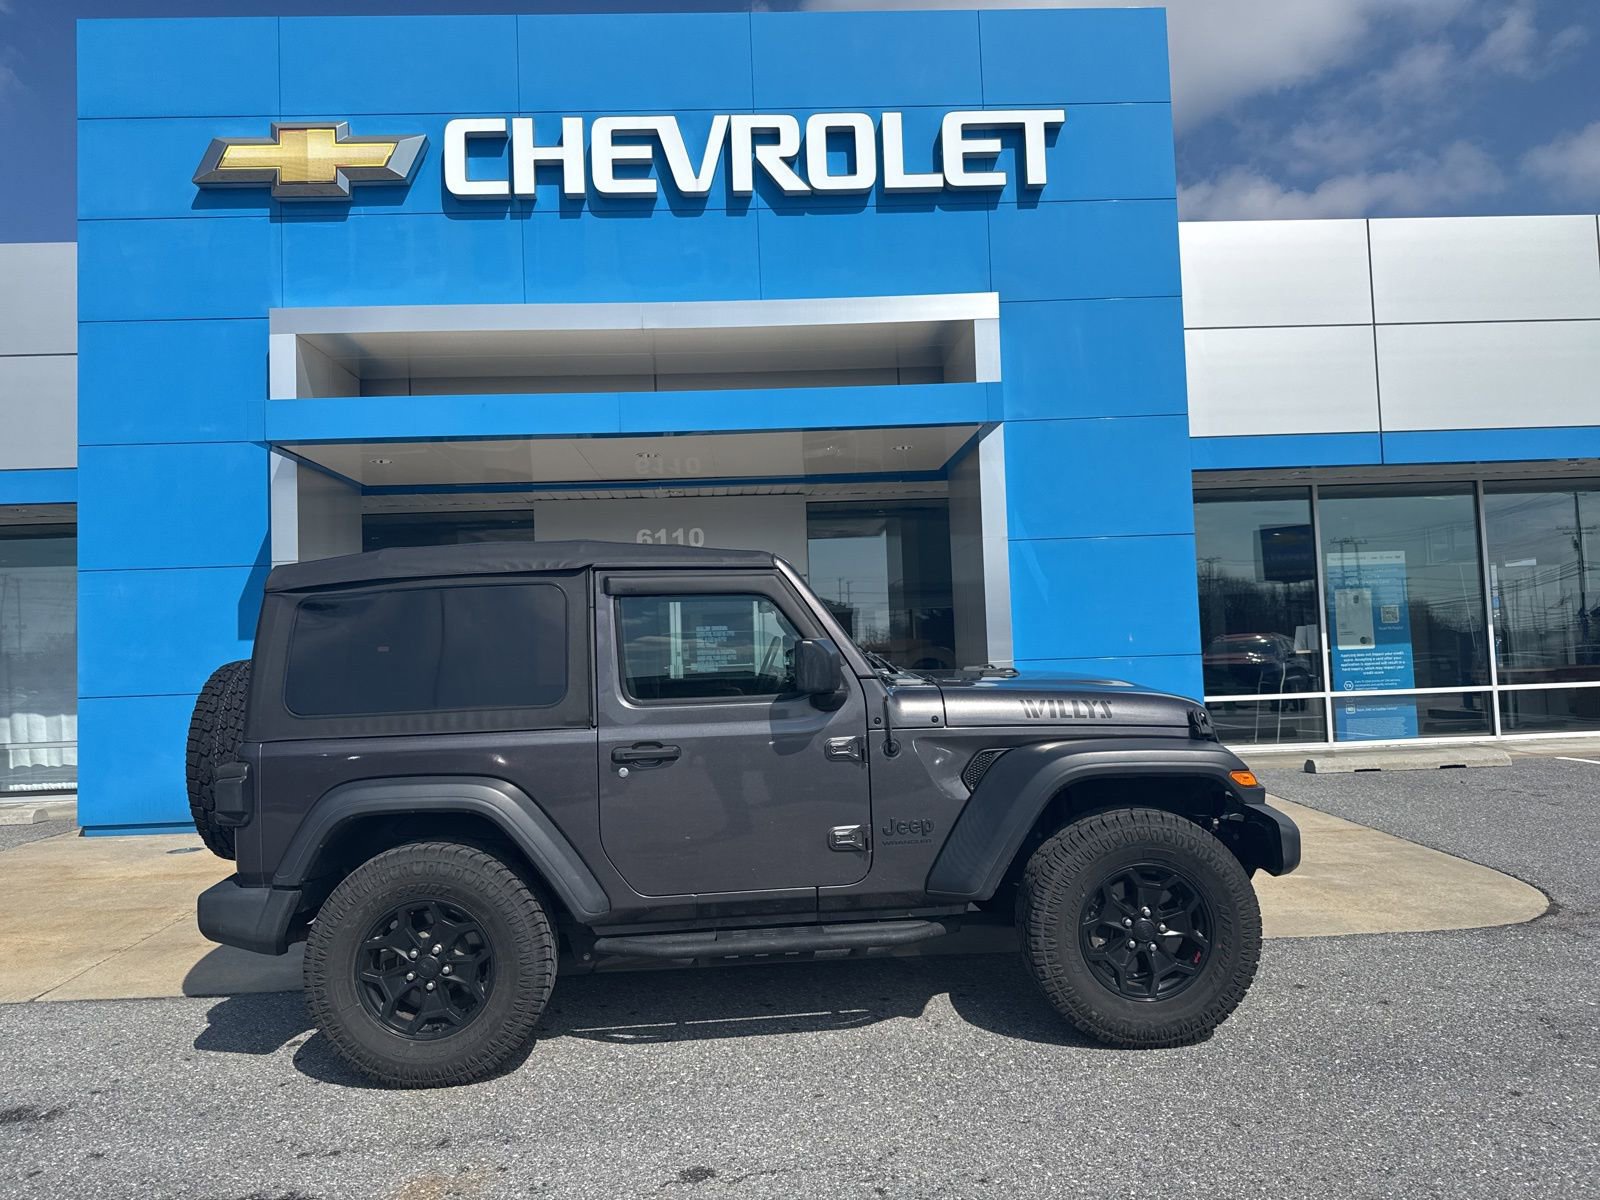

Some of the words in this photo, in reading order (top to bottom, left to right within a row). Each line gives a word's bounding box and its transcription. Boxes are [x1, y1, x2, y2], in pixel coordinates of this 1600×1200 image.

[443, 109, 1065, 196] CHEVROLET
[636, 527, 704, 547] 6110
[1020, 700, 1112, 718] WILLYS
[882, 818, 935, 836] Jeep
